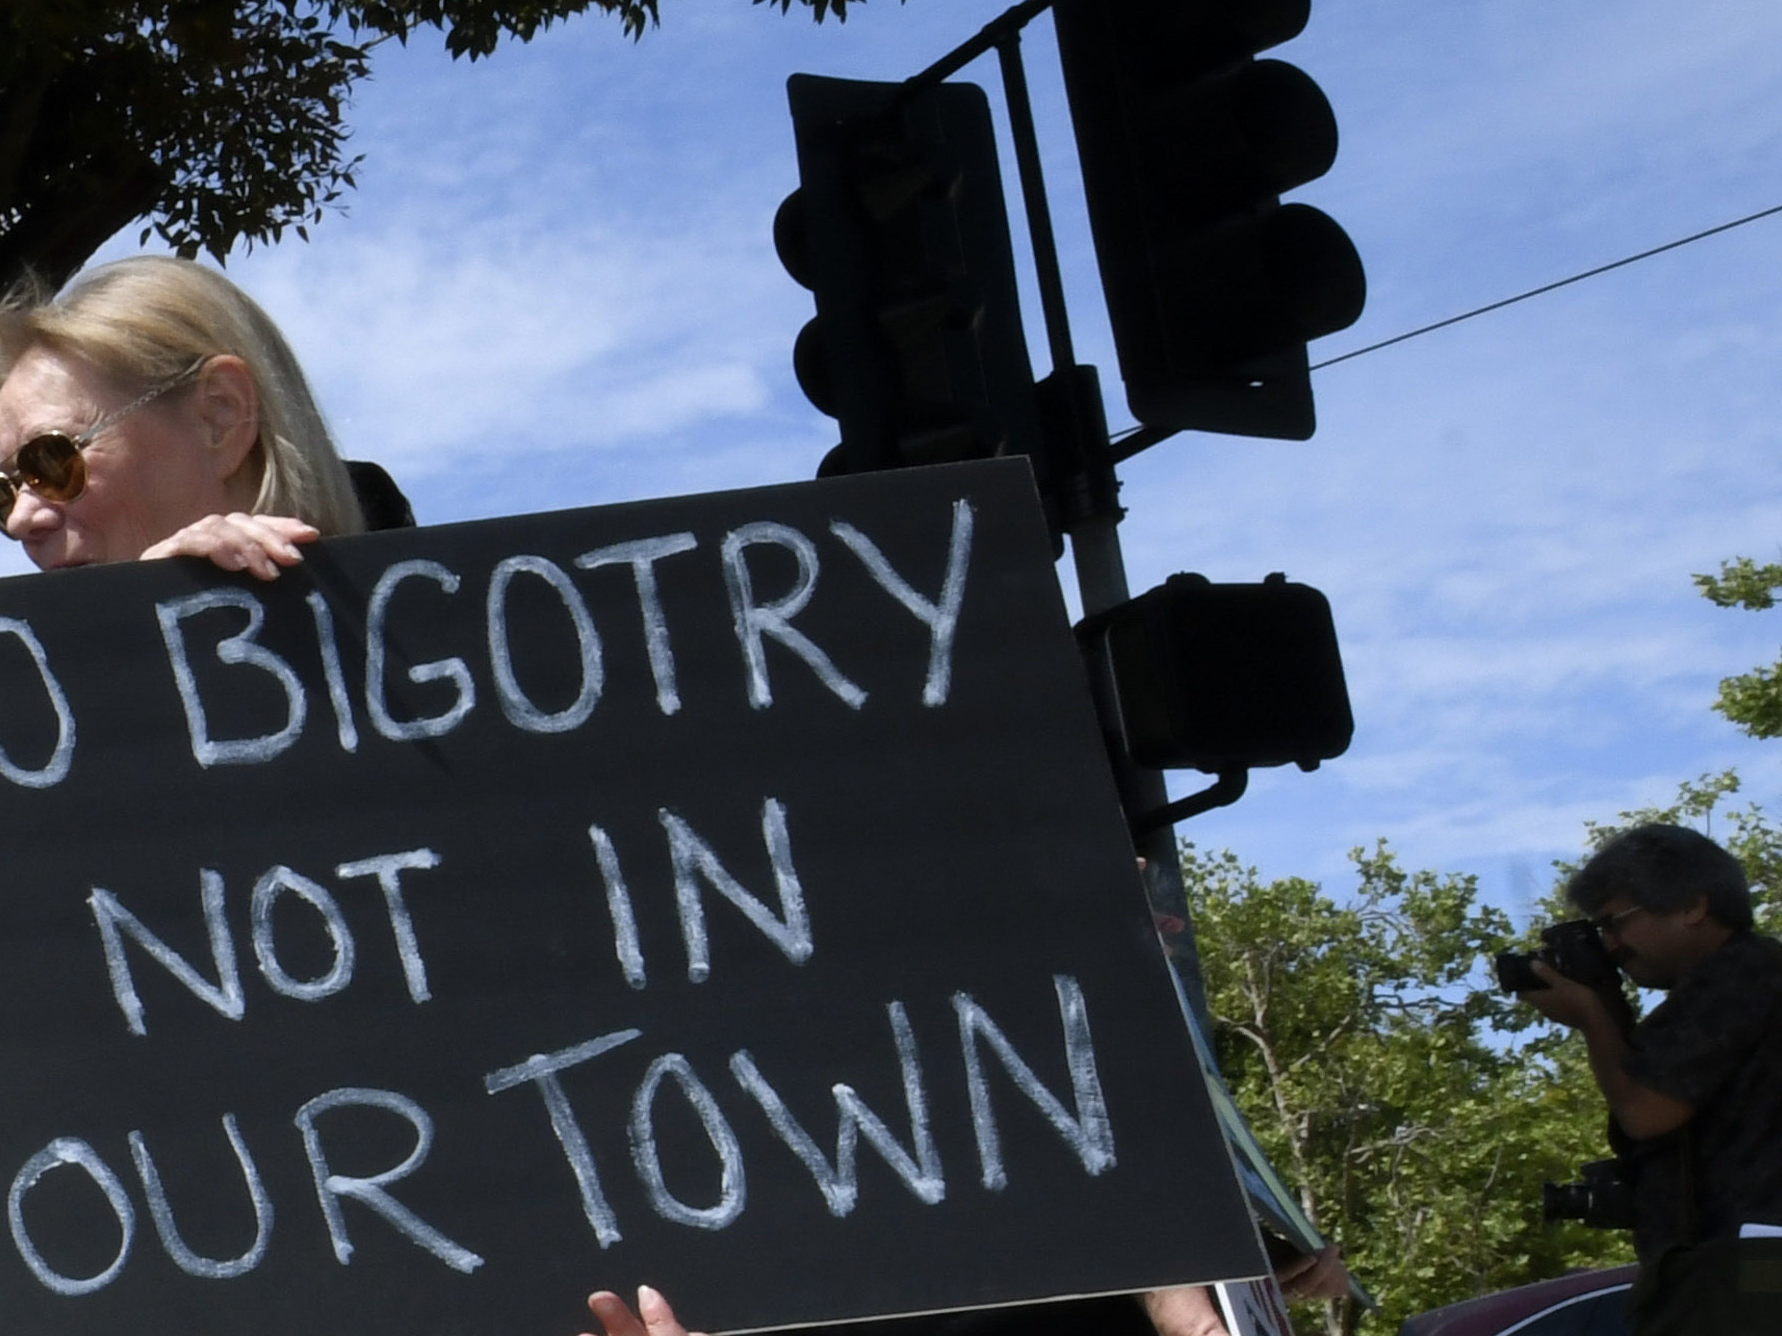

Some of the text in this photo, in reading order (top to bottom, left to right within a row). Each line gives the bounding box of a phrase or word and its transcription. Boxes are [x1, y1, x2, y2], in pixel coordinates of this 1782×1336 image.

[156, 498, 976, 770] BIGOTRY
[88, 795, 815, 1036] NOT IN
[6, 973, 1118, 1297] OUR TOWN
